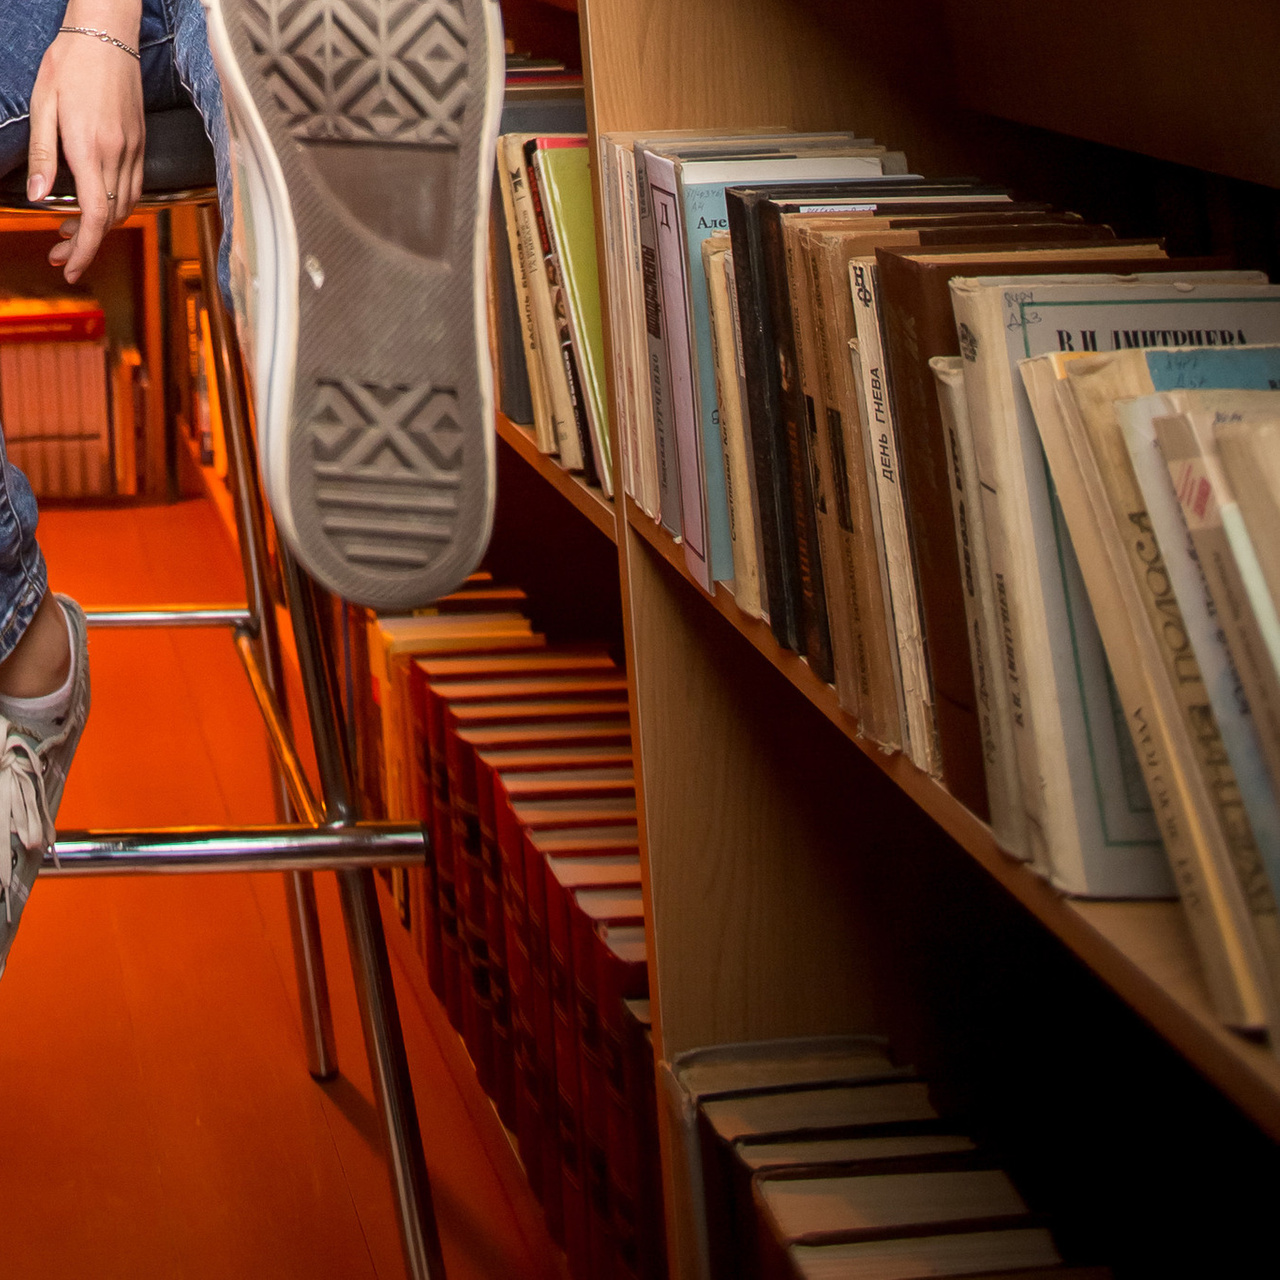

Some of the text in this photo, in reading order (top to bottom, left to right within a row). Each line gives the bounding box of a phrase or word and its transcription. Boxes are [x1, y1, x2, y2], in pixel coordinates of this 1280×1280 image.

[660, 201, 671, 233] Д
[516, 242, 536, 350] ВАСИЛЬ БЫКОВ
[651, 352, 664, 433] ГУРЧЕНКО
[866, 364, 896, 483] ДЕНЬ ГНЕВА
